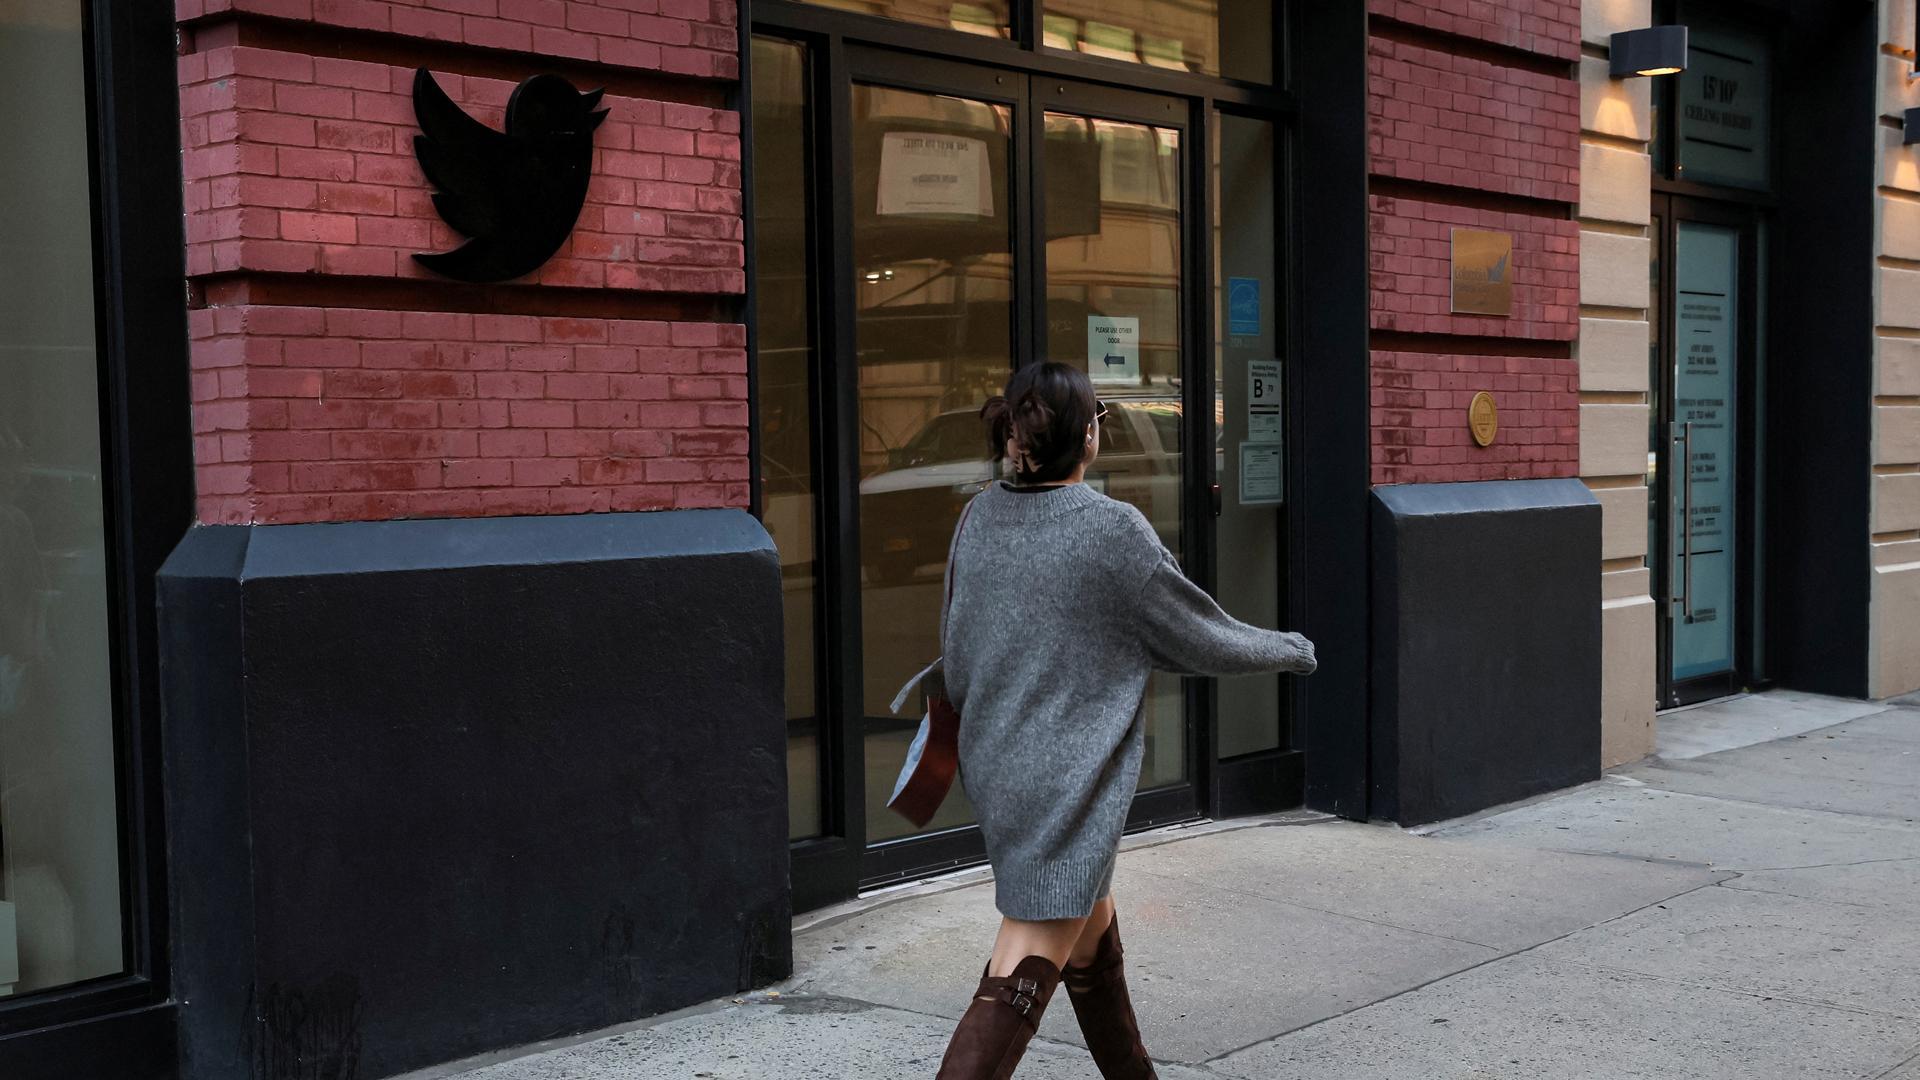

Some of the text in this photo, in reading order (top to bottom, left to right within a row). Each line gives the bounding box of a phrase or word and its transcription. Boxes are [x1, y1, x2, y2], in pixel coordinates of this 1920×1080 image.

[1685, 104, 1719, 124] CEILING
[1095, 326, 1109, 334] PLEASE
[1254, 379, 1263, 398] B
